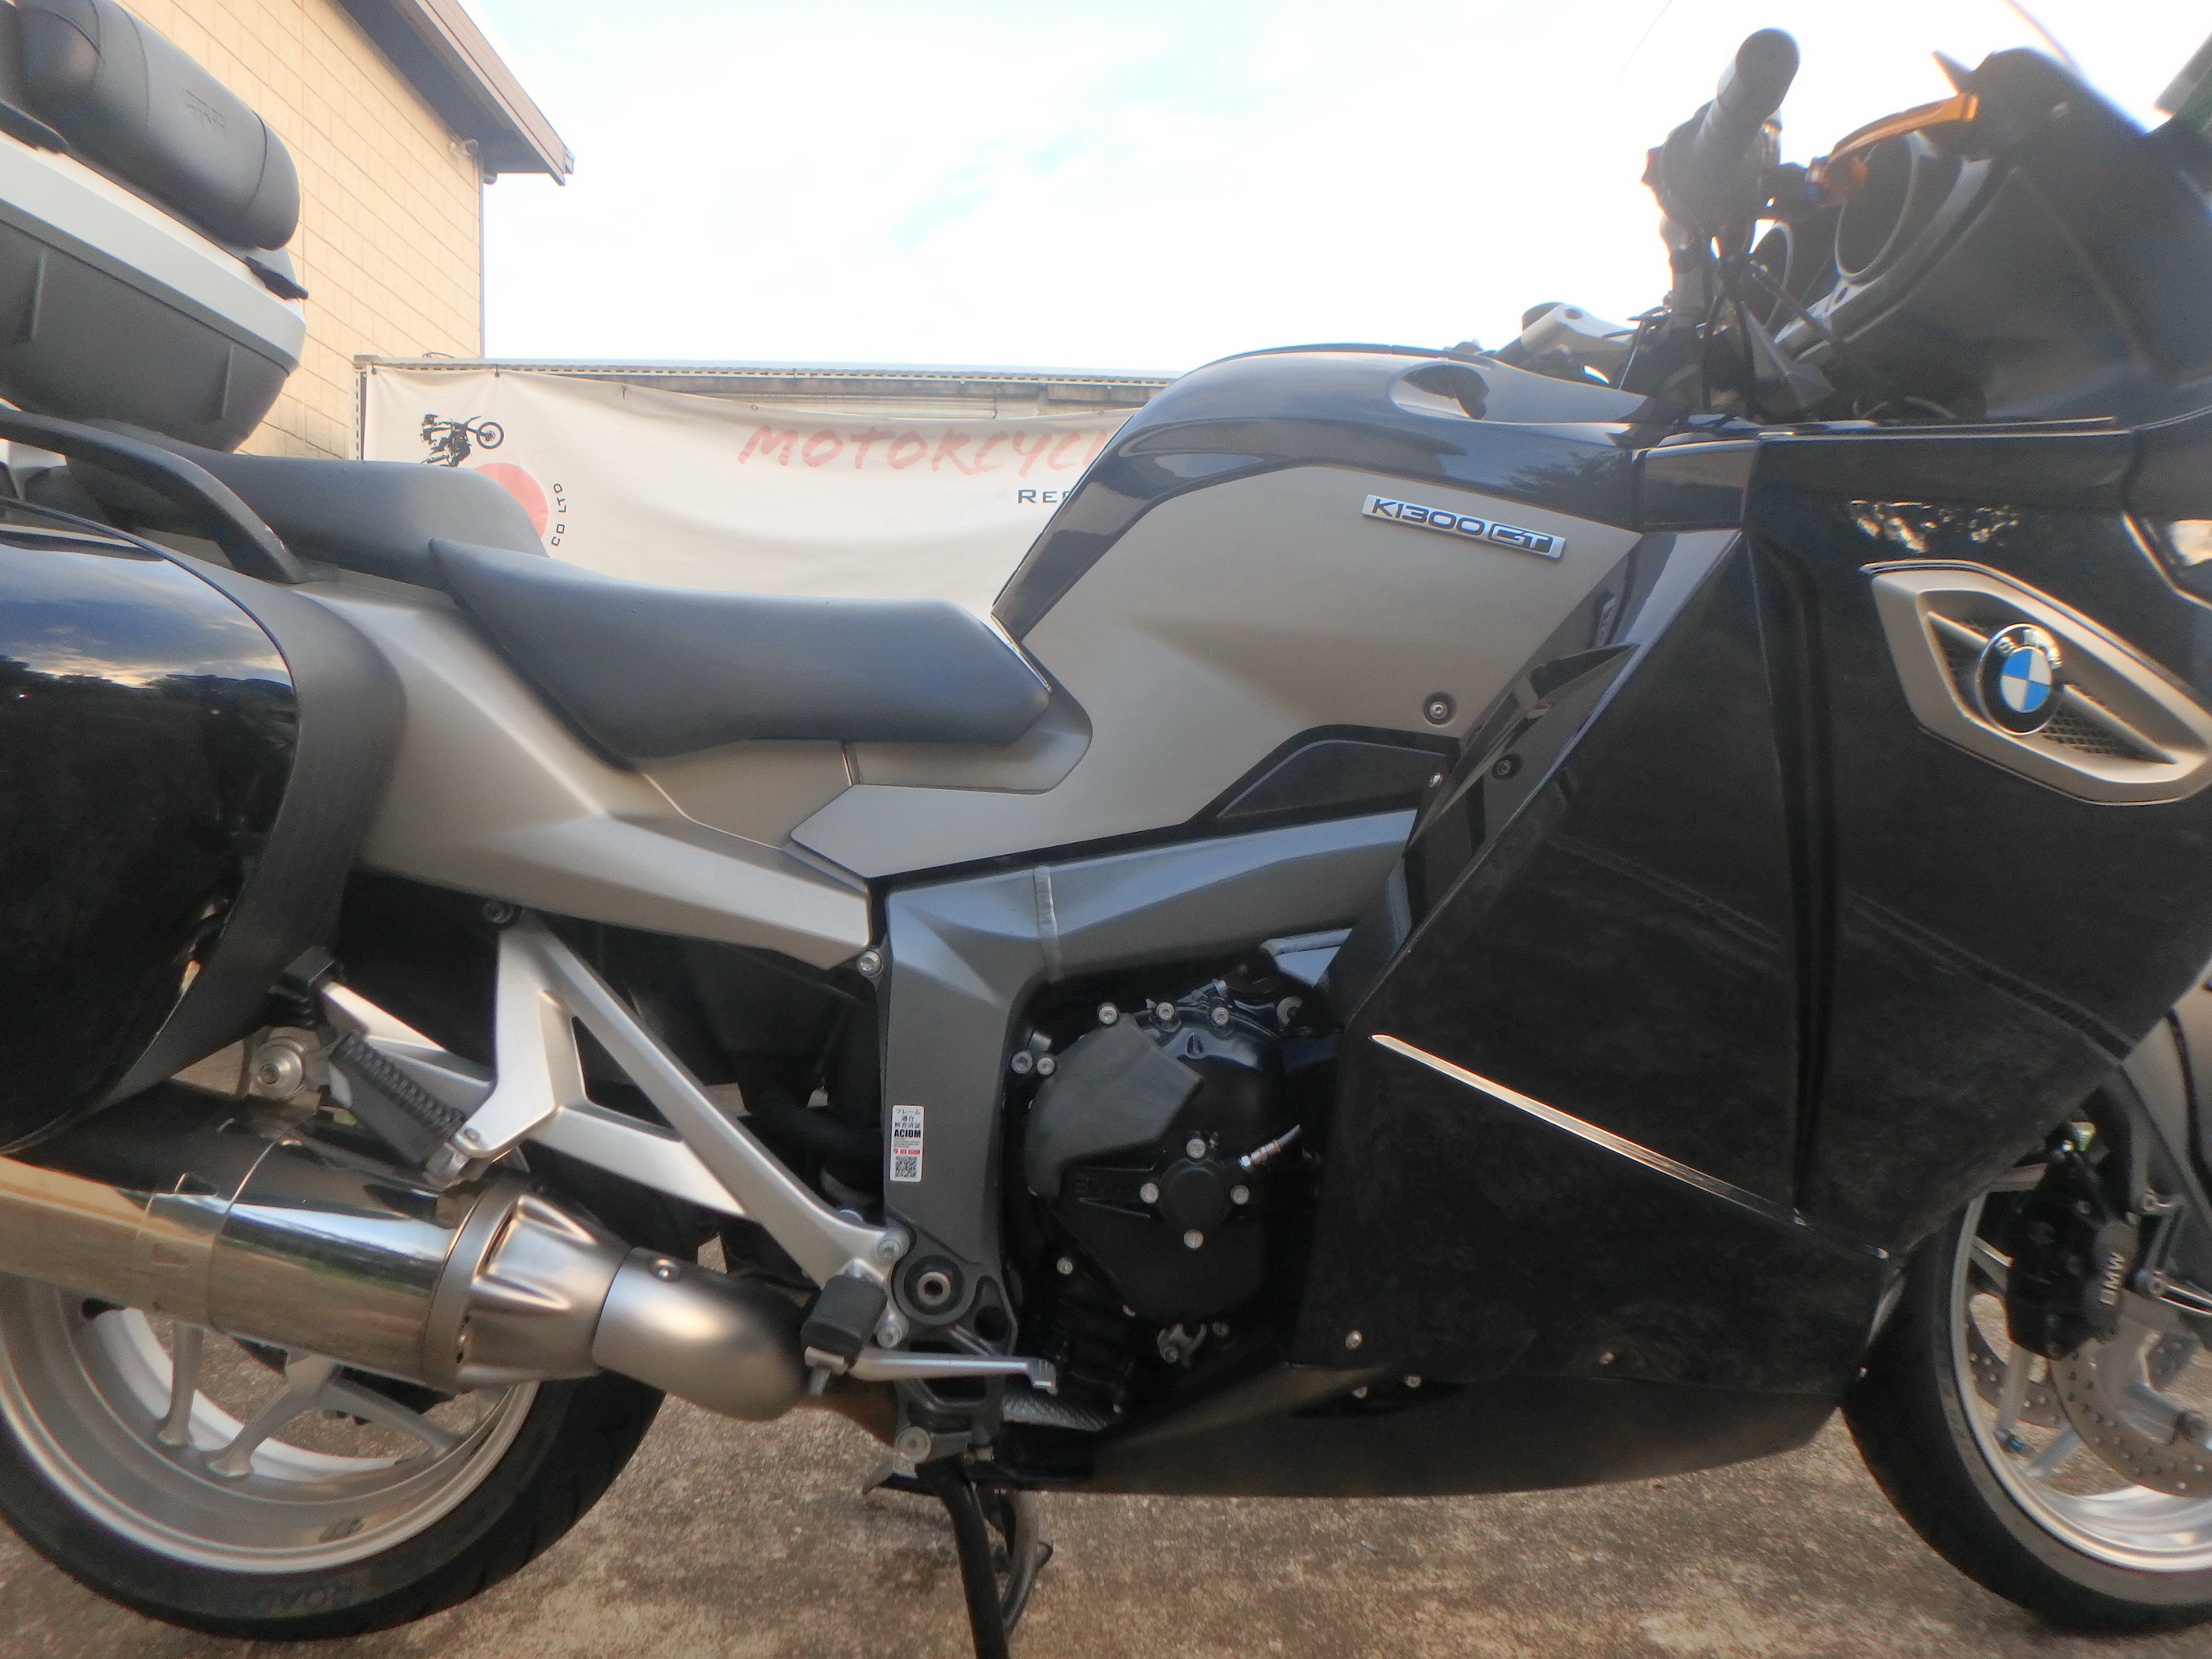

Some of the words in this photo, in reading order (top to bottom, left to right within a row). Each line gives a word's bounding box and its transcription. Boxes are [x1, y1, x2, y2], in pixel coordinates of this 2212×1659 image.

[553, 483, 567, 514] LTD
[551, 523, 566, 547] CO
[1371, 498, 1486, 536] K1300
[1488, 523, 1554, 553] GT
[893, 1129, 921, 1138] ACIDM
[2097, 1251, 2127, 1306] BMW
